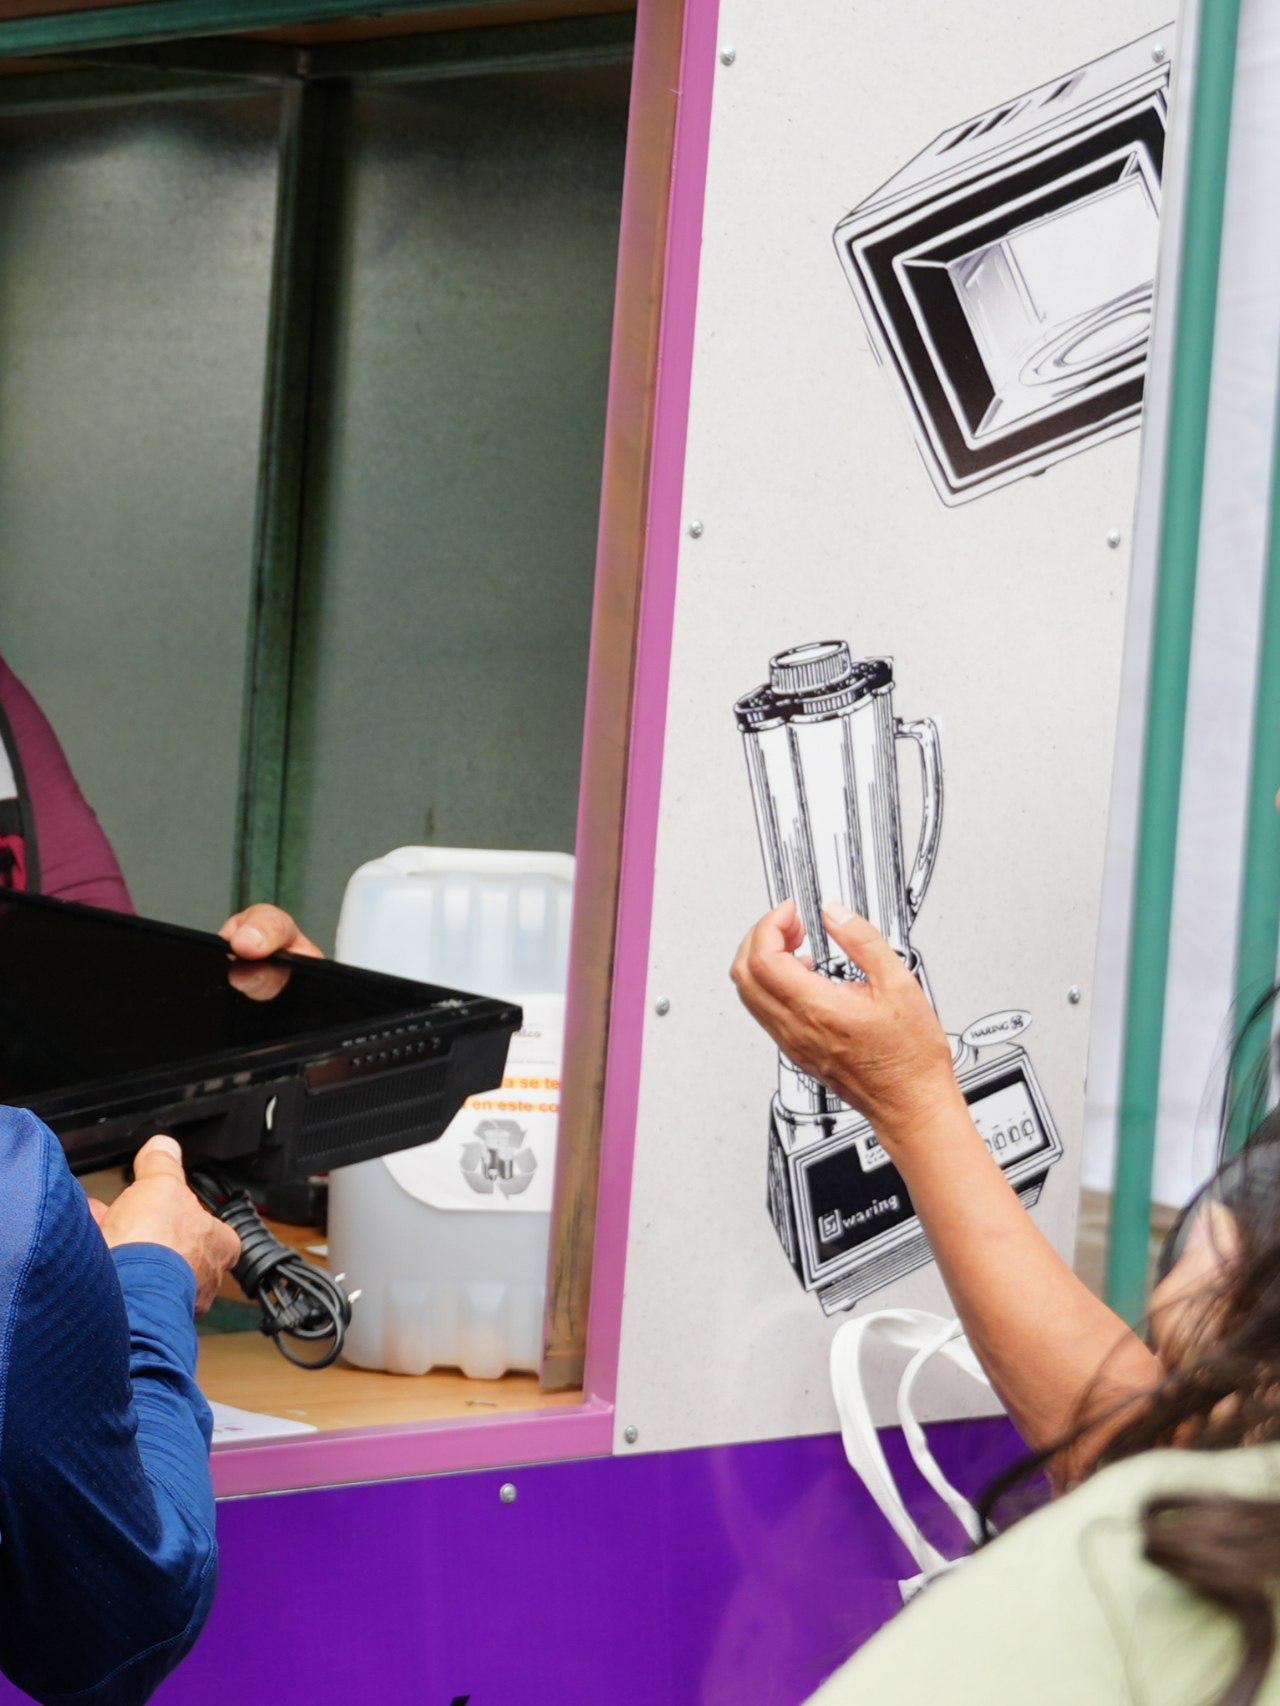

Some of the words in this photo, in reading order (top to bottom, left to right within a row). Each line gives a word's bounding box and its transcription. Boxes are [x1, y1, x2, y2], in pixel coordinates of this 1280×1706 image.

[520, 1079, 539, 1089] se
[472, 1101, 492, 1110] en
[497, 1101, 533, 1111] este
[842, 1194, 900, 1229] waring
